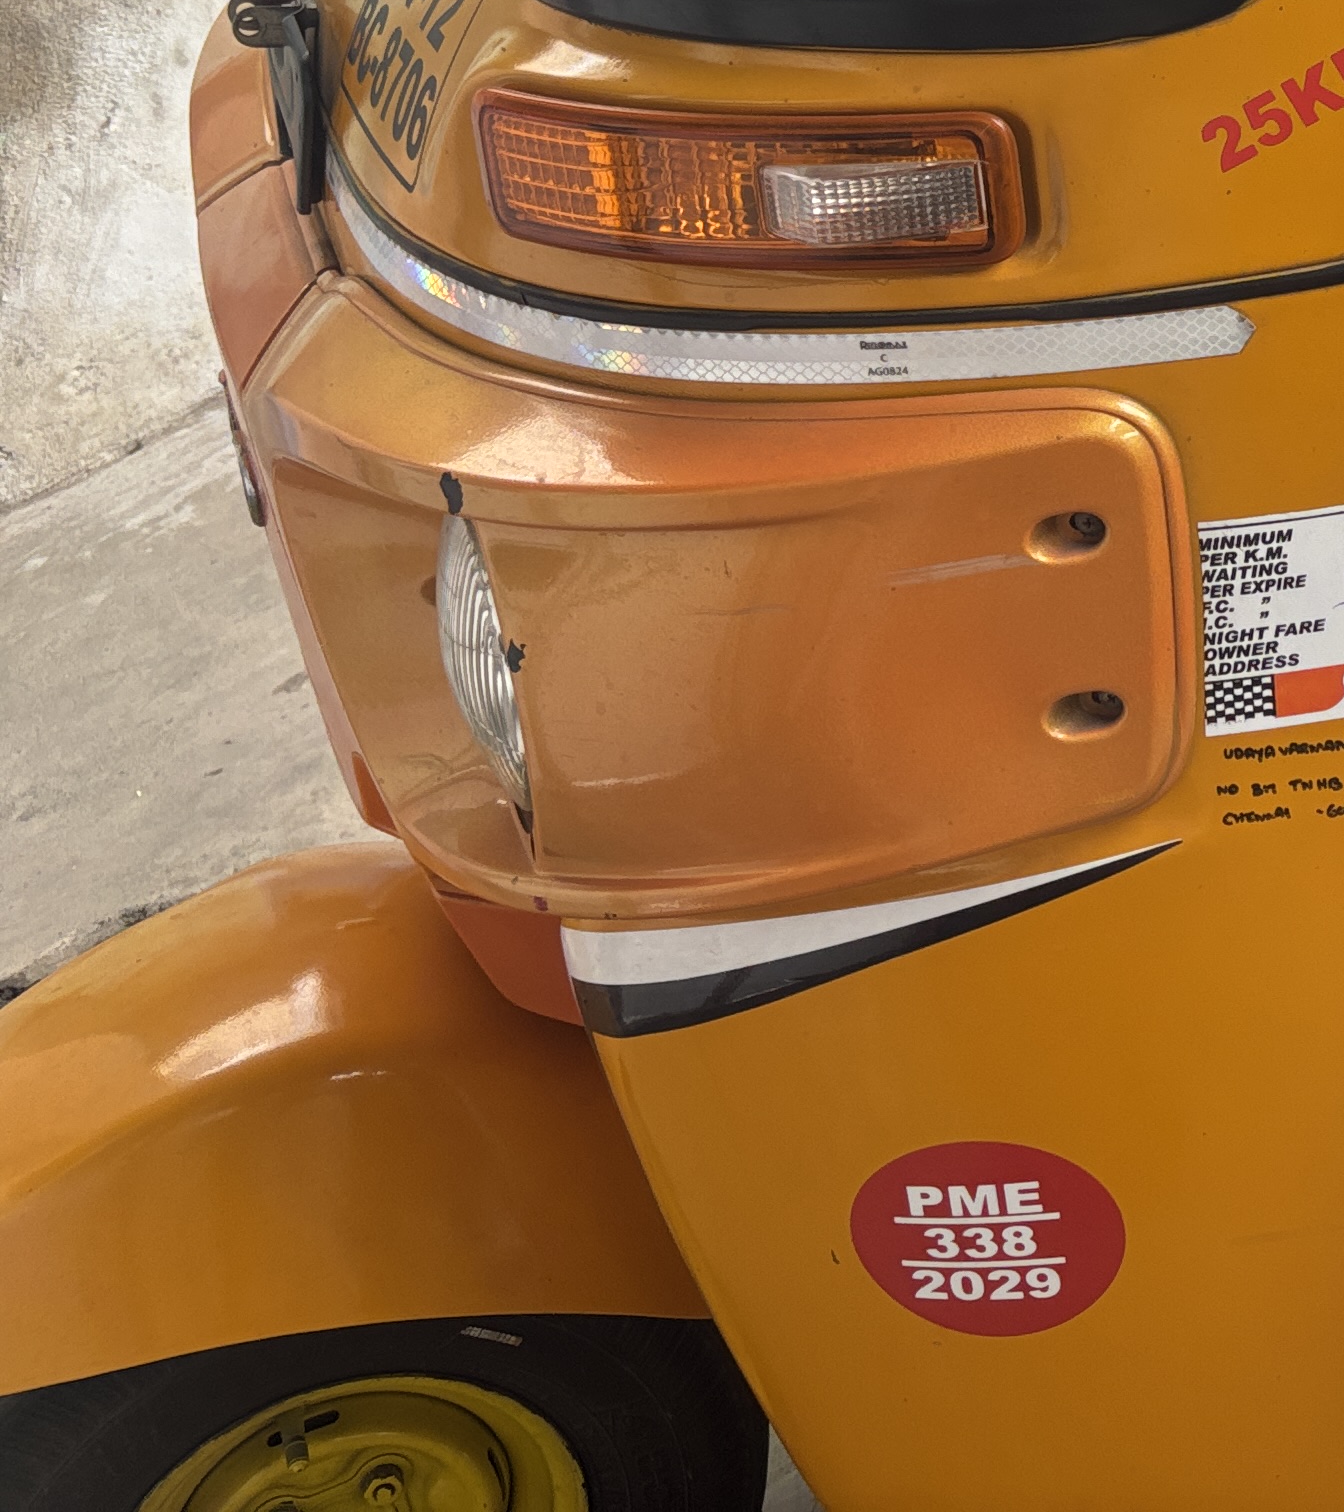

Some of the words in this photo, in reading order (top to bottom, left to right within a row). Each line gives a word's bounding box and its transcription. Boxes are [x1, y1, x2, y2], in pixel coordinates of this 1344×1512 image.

[1199, 528, 1294, 552] MINIMUM
[1243, 545, 1289, 564] K.M.
[1239, 574, 1308, 596] EXPIRE
[1203, 626, 1270, 647] NIGHT
[1273, 618, 1327, 639] FARE
[1204, 640, 1280, 662] OWNER
[1204, 653, 1301, 678] ADDRESS
[905, 1180, 1044, 1217] PME
[923, 1225, 1037, 1259] 338
[911, 1267, 1062, 1301] 2029
